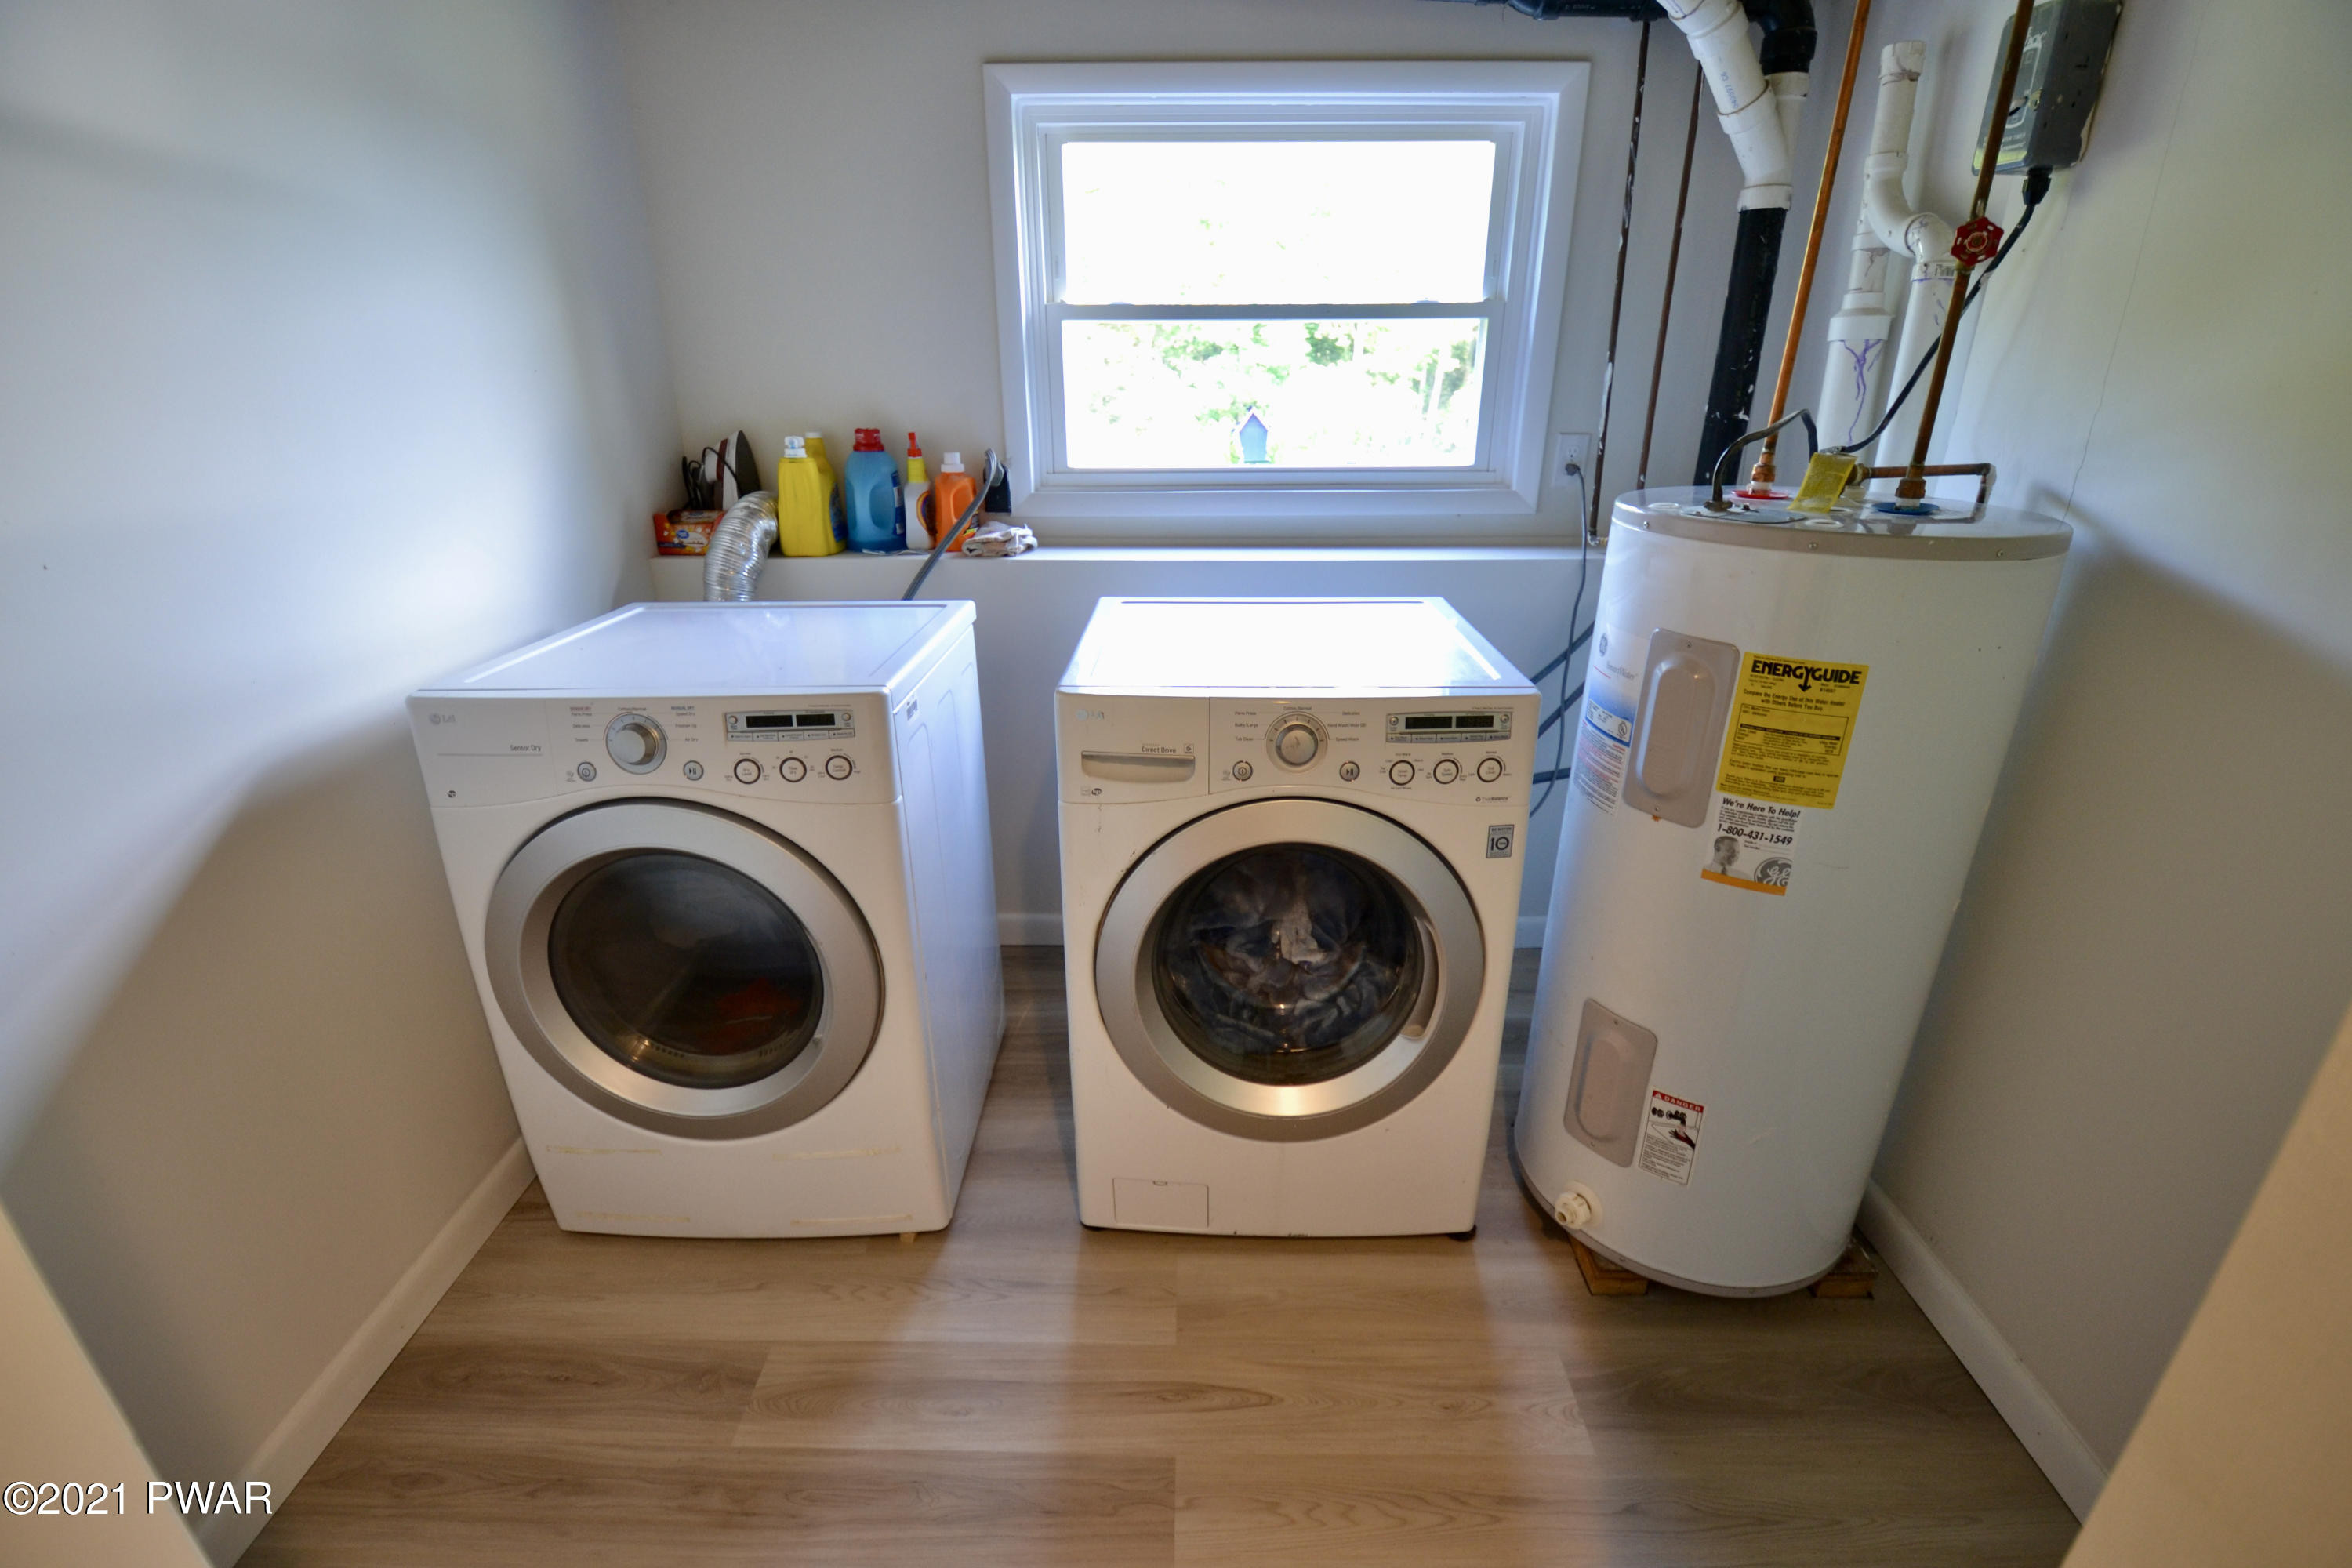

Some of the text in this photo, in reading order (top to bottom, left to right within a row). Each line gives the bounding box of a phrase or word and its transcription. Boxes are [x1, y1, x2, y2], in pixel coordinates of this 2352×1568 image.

[1751, 659, 1862, 685] ENERGYGUIDE
[1743, 688, 1762, 697] Compare
[1772, 691, 1788, 702] Energy
[1722, 797, 1801, 819] We're Here To Help!
[1490, 836, 1510, 851] 10
[1717, 823, 1793, 846] 1-800-431-1549
[1664, 1096, 1701, 1112] DANGER
